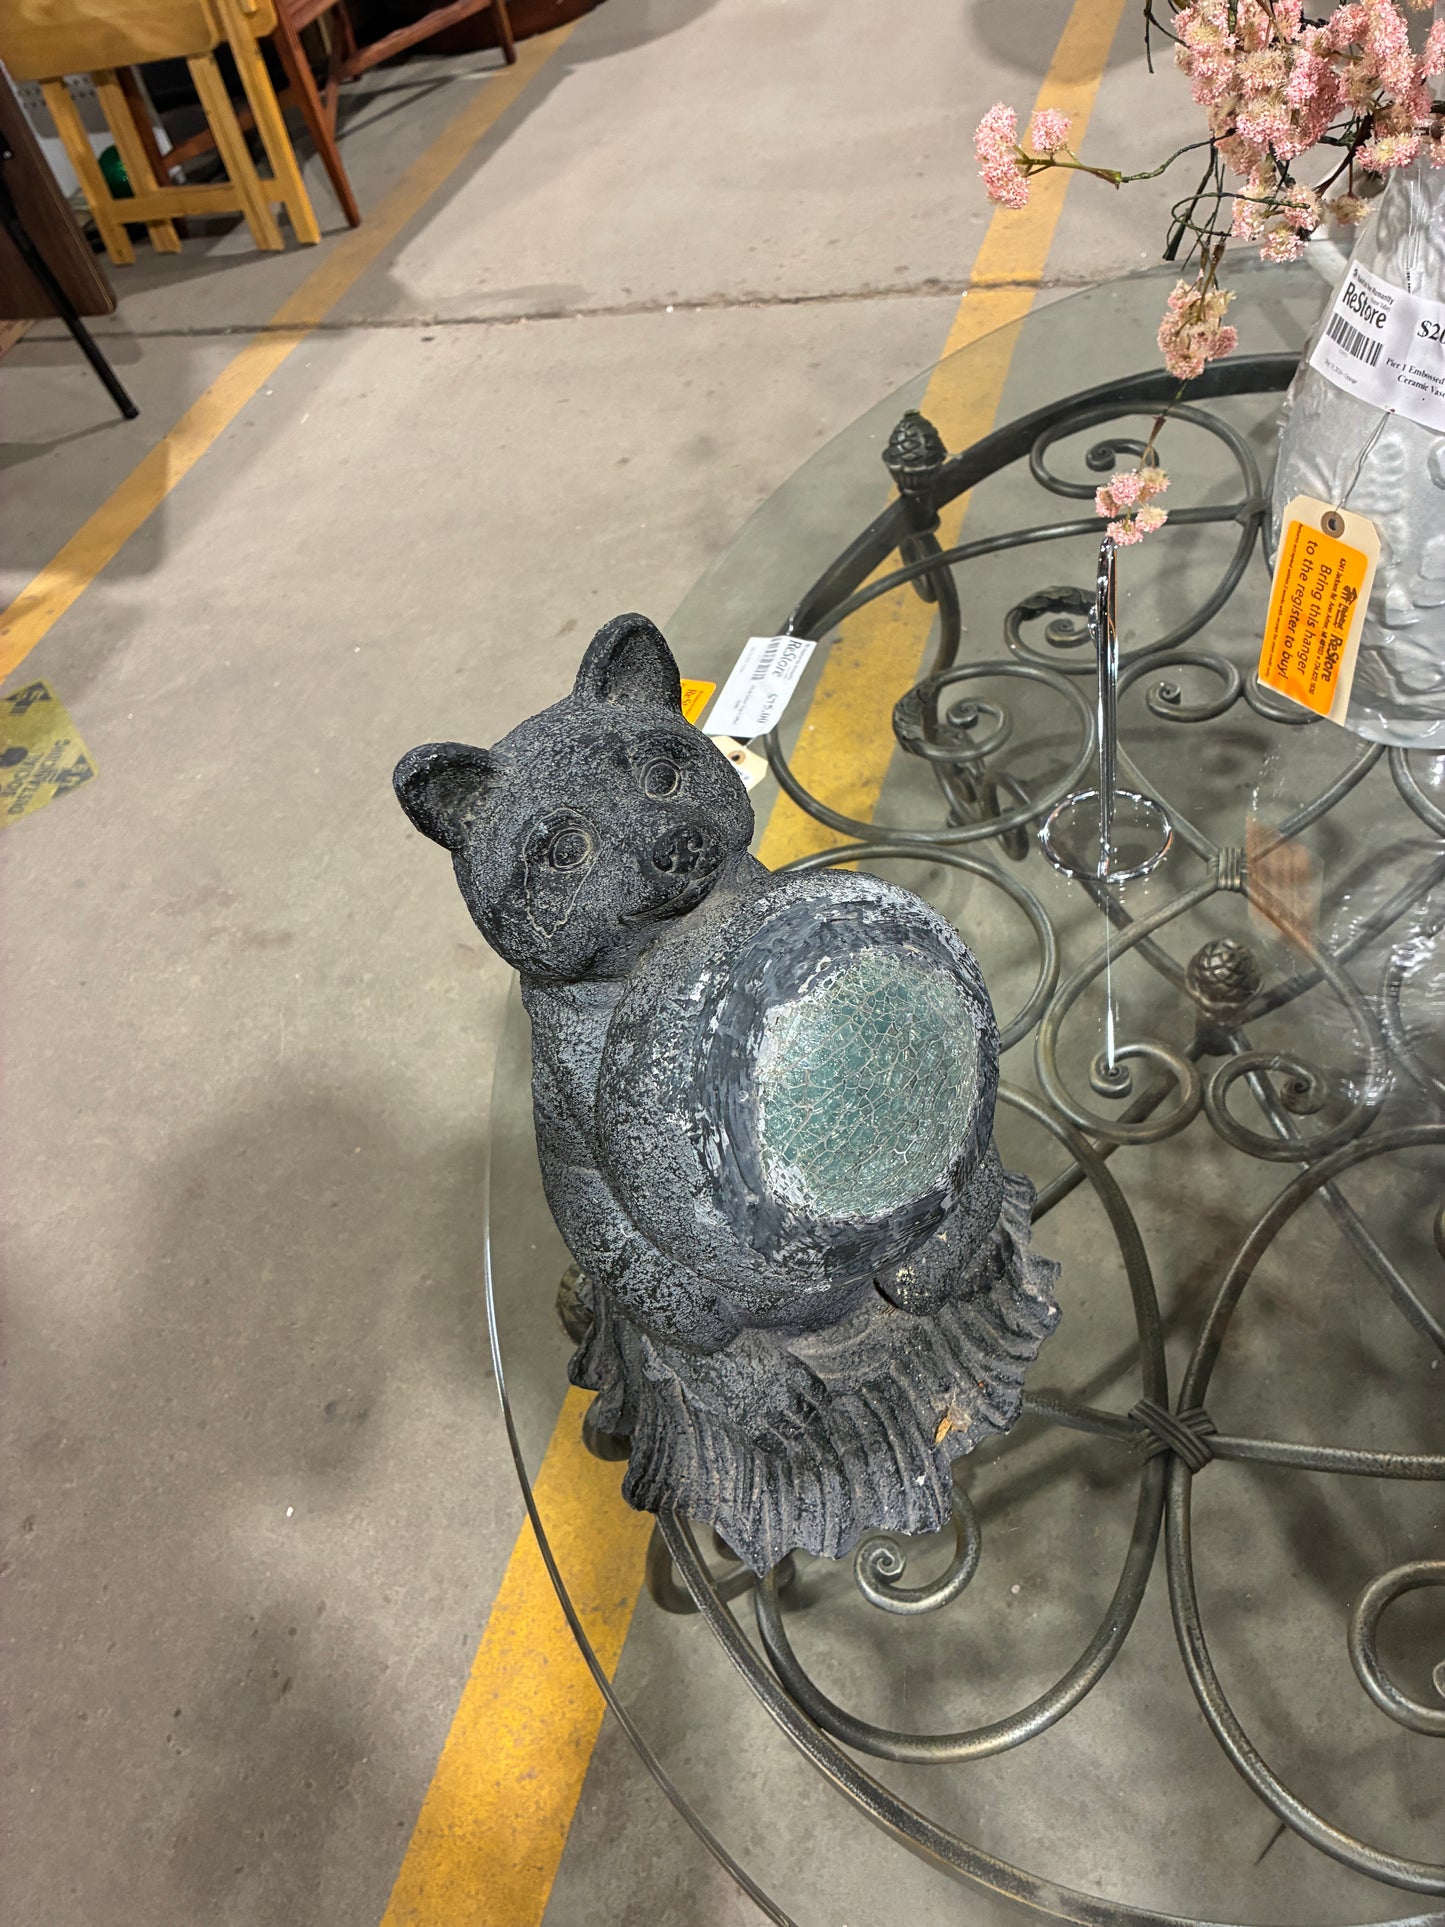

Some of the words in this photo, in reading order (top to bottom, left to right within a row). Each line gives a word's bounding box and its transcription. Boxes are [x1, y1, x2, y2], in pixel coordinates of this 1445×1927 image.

[1342, 282, 1387, 329] ReStore
[1386, 357, 1401, 369] Pier
[1401, 363, 1407, 372] 1
[1408, 365, 1445, 386] Embossed
[1397, 374, 1429, 392] Ceramic
[1305, 540, 1318, 555] to
[1299, 558, 1313, 581] the
[1310, 563, 1332, 601] Bring
[1287, 583, 1305, 634] register
[1306, 603, 1321, 628] this
[1284, 634, 1294, 648] to
[1296, 629, 1316, 674] hanger
[773, 639, 802, 678] ReStore
[1276, 650, 1293, 679] buy!
[1321, 633, 1343, 682] ReStore
